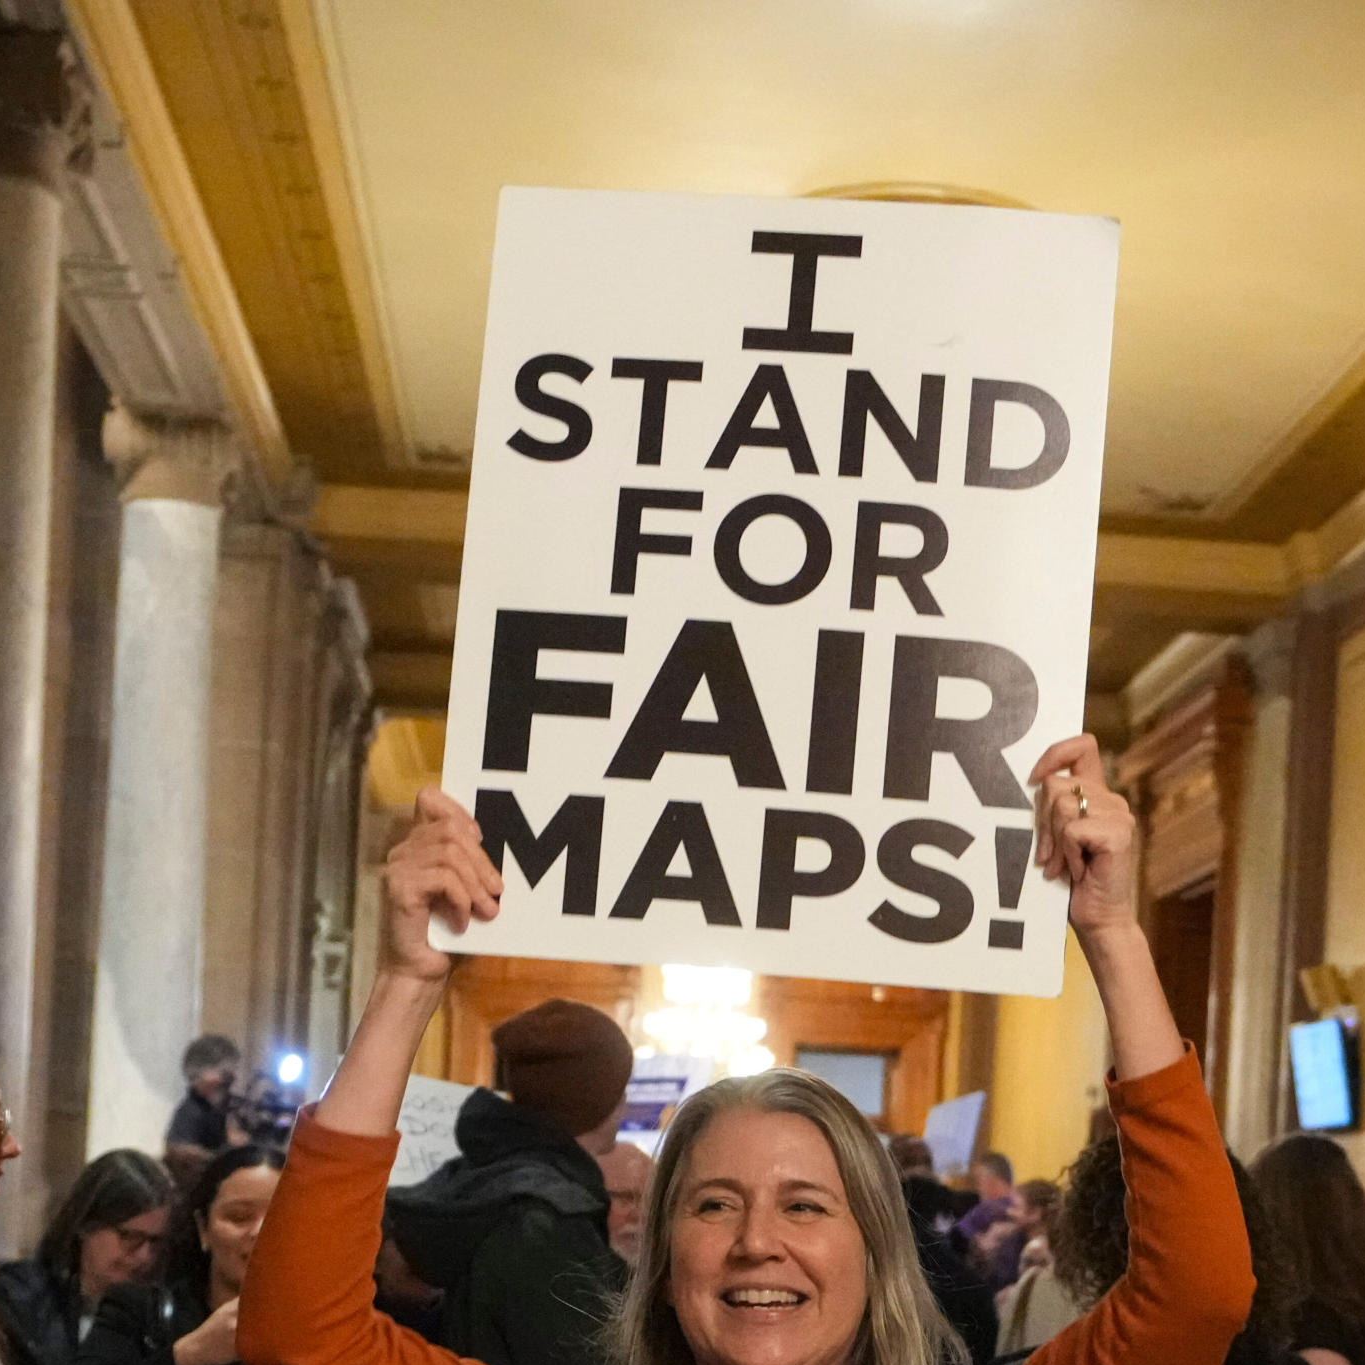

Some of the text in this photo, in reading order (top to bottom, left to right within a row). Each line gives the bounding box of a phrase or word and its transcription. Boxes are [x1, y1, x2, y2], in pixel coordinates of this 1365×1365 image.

[742, 230, 863, 355] I
[506, 352, 1071, 490] STAND
[610, 487, 949, 617] FOR
[481, 609, 1040, 810] FAIR
[474, 789, 1034, 950] MAPS!
